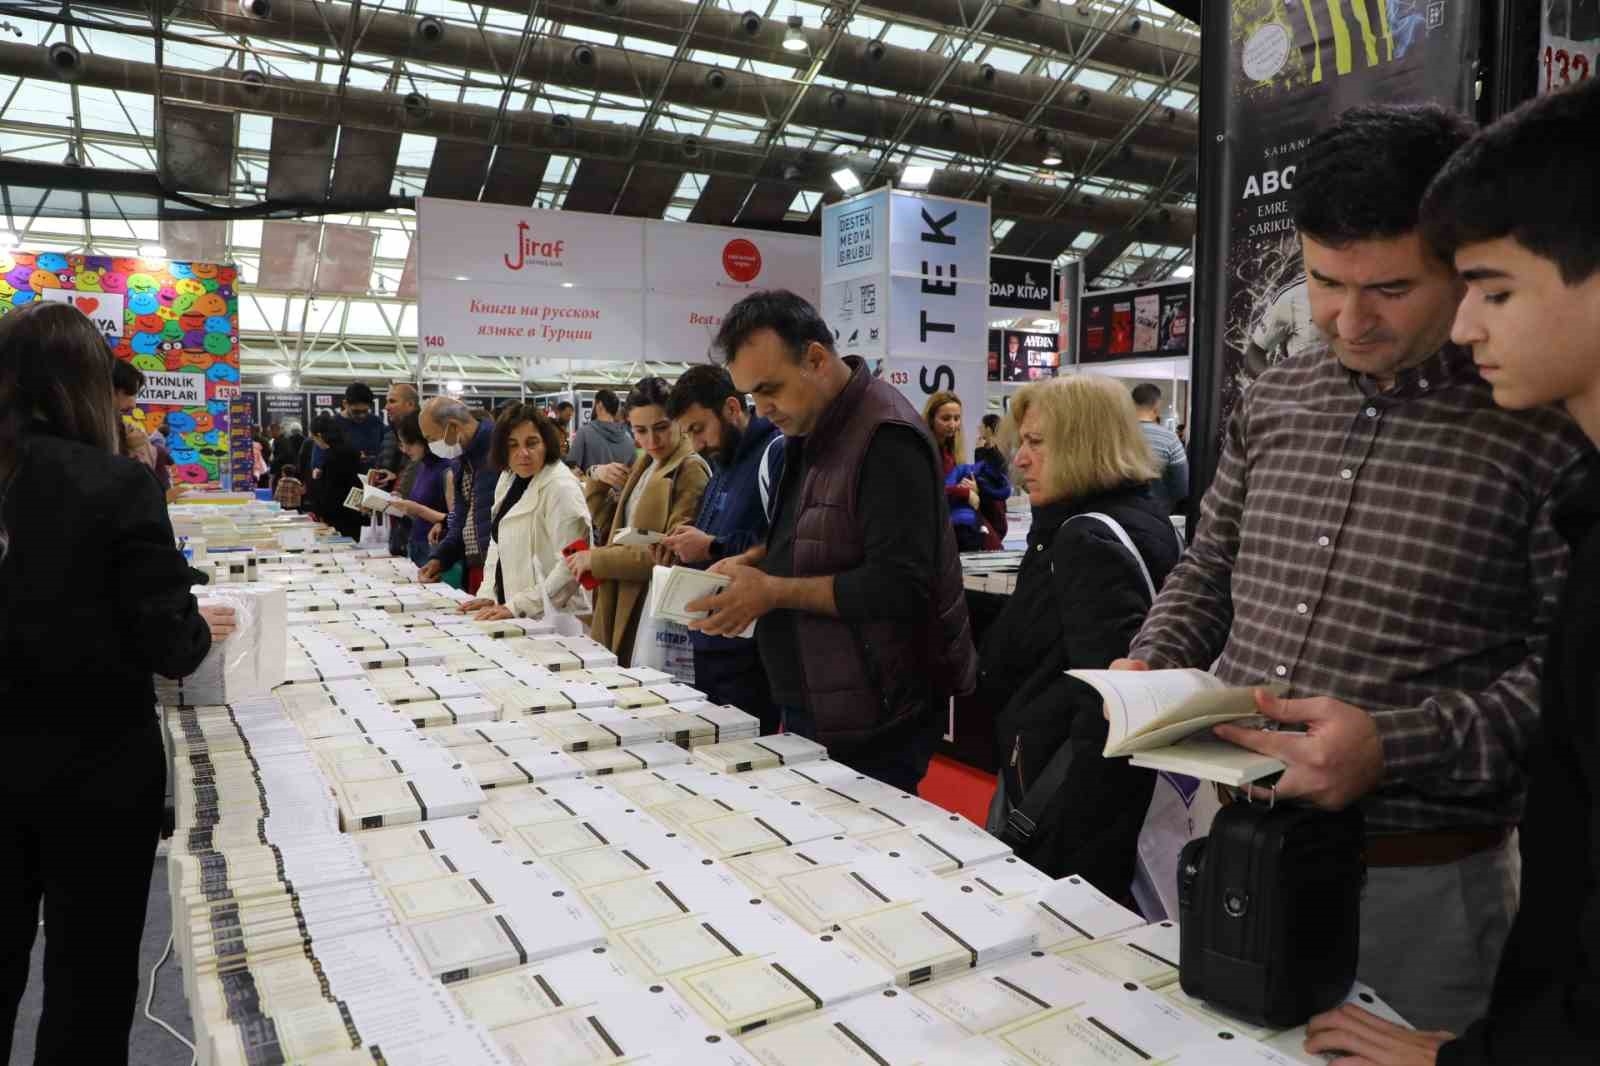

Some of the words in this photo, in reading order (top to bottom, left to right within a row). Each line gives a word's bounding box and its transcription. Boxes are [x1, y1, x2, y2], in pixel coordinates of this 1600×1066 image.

[1257, 200, 1288, 217] EMRE
[840, 212, 871, 232] DESTEK
[504, 221, 565, 271] Jiraf
[840, 228, 871, 248] MEDYA
[839, 245, 871, 263] GRUBU
[470, 299, 517, 316] Книги
[520, 304, 539, 316] на
[542, 304, 601, 321] русском
[424, 335, 445, 348] 140
[478, 323, 524, 338] языке
[527, 327, 537, 338] в
[541, 325, 593, 342] Турции
[890, 371, 909, 385] 133
